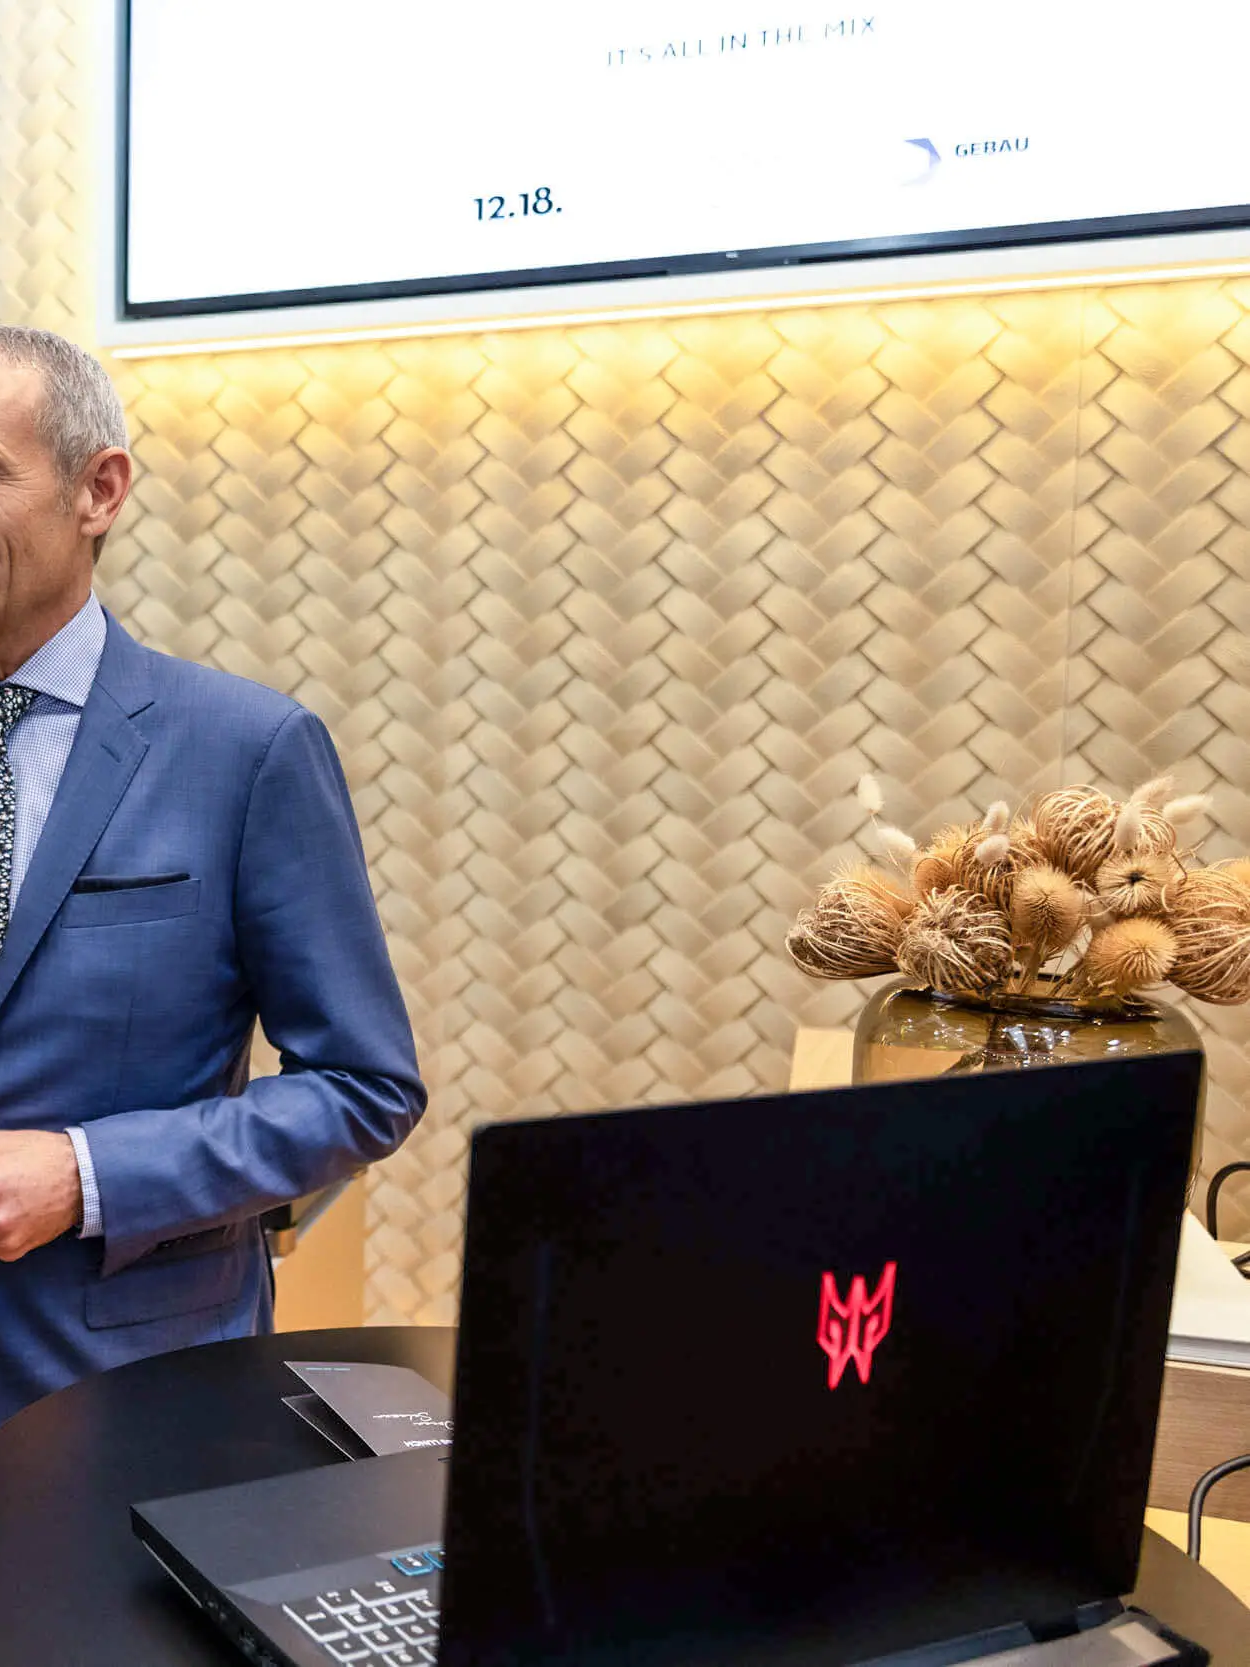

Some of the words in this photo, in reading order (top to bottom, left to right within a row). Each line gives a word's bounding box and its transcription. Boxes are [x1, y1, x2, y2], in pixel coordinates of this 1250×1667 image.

[662, 39, 710, 59] ALL
[719, 32, 747, 54] IN
[823, 16, 875, 39] MIX
[955, 137, 1029, 157] GEBAU
[473, 186, 562, 221] 12.18.
